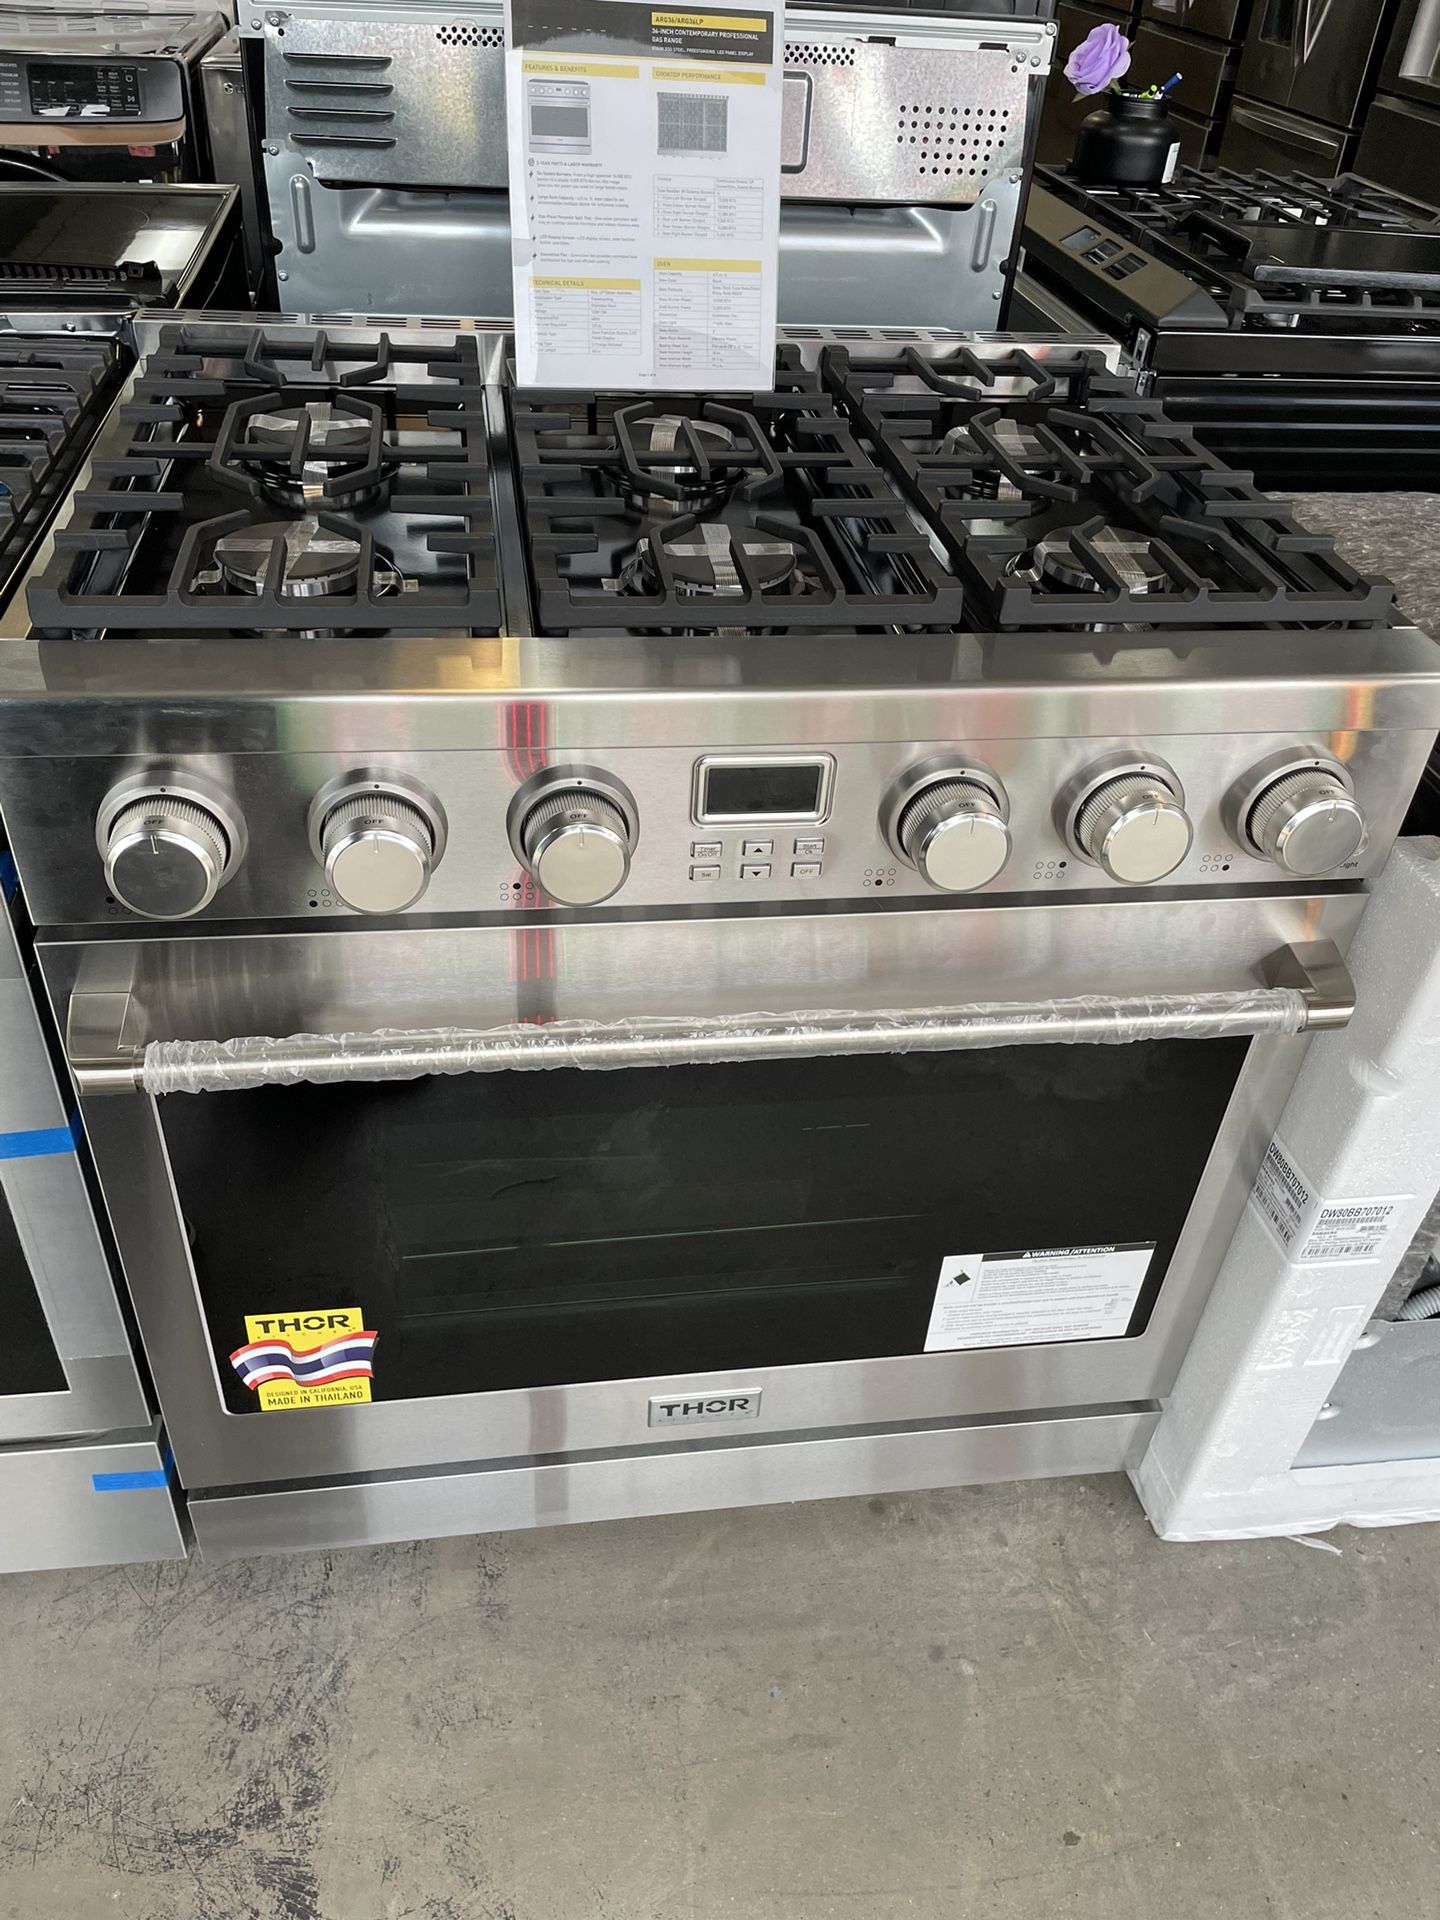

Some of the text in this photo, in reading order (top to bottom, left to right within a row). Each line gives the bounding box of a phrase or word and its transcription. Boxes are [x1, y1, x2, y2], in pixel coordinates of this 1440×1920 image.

[655, 16, 704, 25] ARG36/ARG36LP
[651, 28, 759, 41] 36-INCH CONTEMPORARY PROFESSIONAL
[524, 63, 553, 72] FEATURES
[560, 65, 587, 73] BENEFITS
[655, 70, 721, 80] COOKTOP PERFORMANCE
[1268, 1141, 1309, 1205] DW80BB707012
[1320, 1205, 1394, 1218] DW80BB707012
[255, 1314, 351, 1334] THOR
[266, 1390, 299, 1398] DESIGNED
[267, 1390, 363, 1406] MADE IN THAILAND
[659, 1398, 750, 1417] THOR
